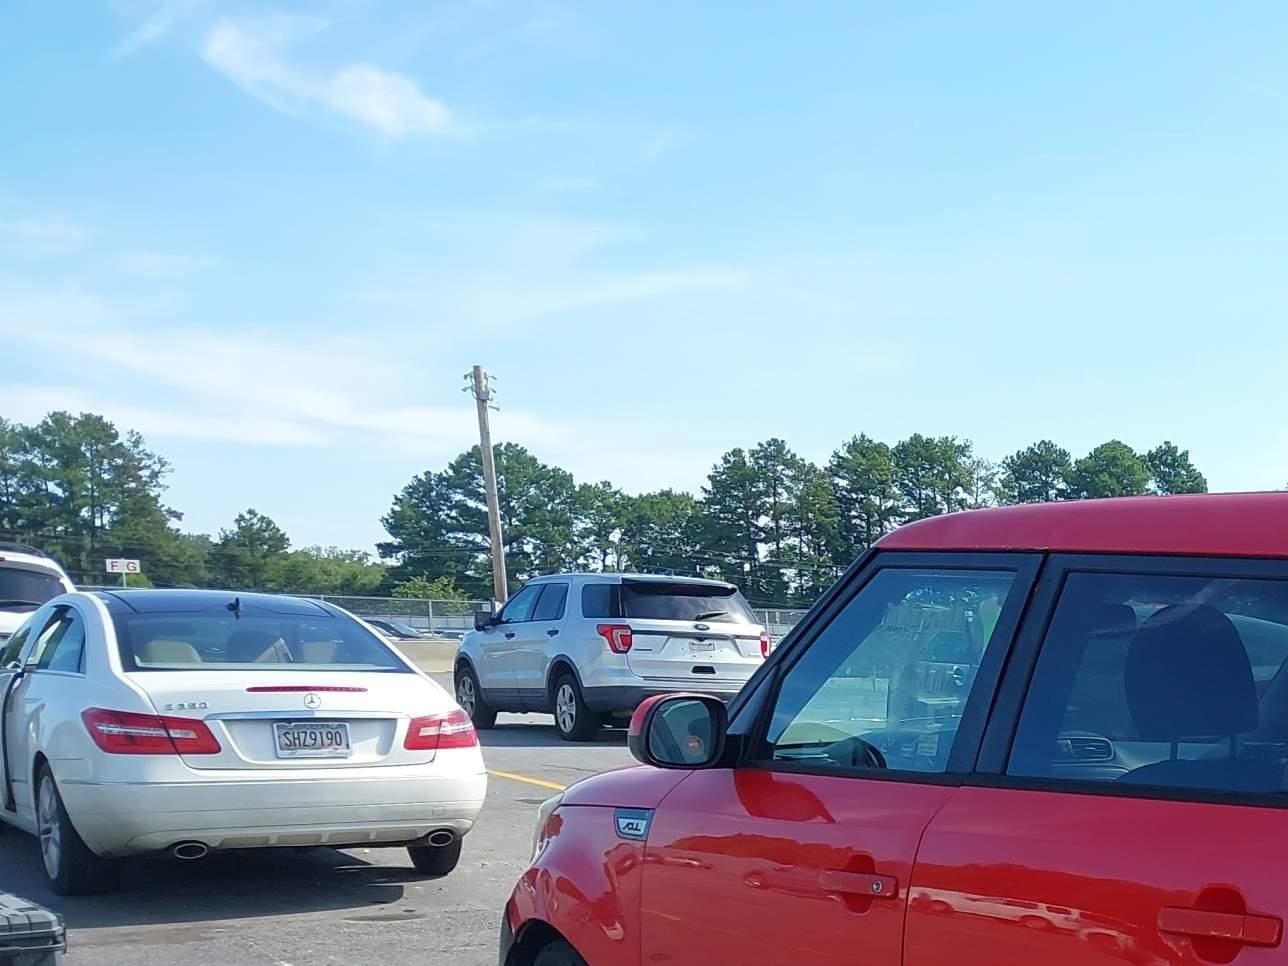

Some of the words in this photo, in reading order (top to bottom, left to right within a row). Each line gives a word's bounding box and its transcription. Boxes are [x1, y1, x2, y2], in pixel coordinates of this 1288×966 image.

[111, 561, 118, 571] F
[126, 561, 137, 571] G
[283, 731, 342, 747] SHZ9190
